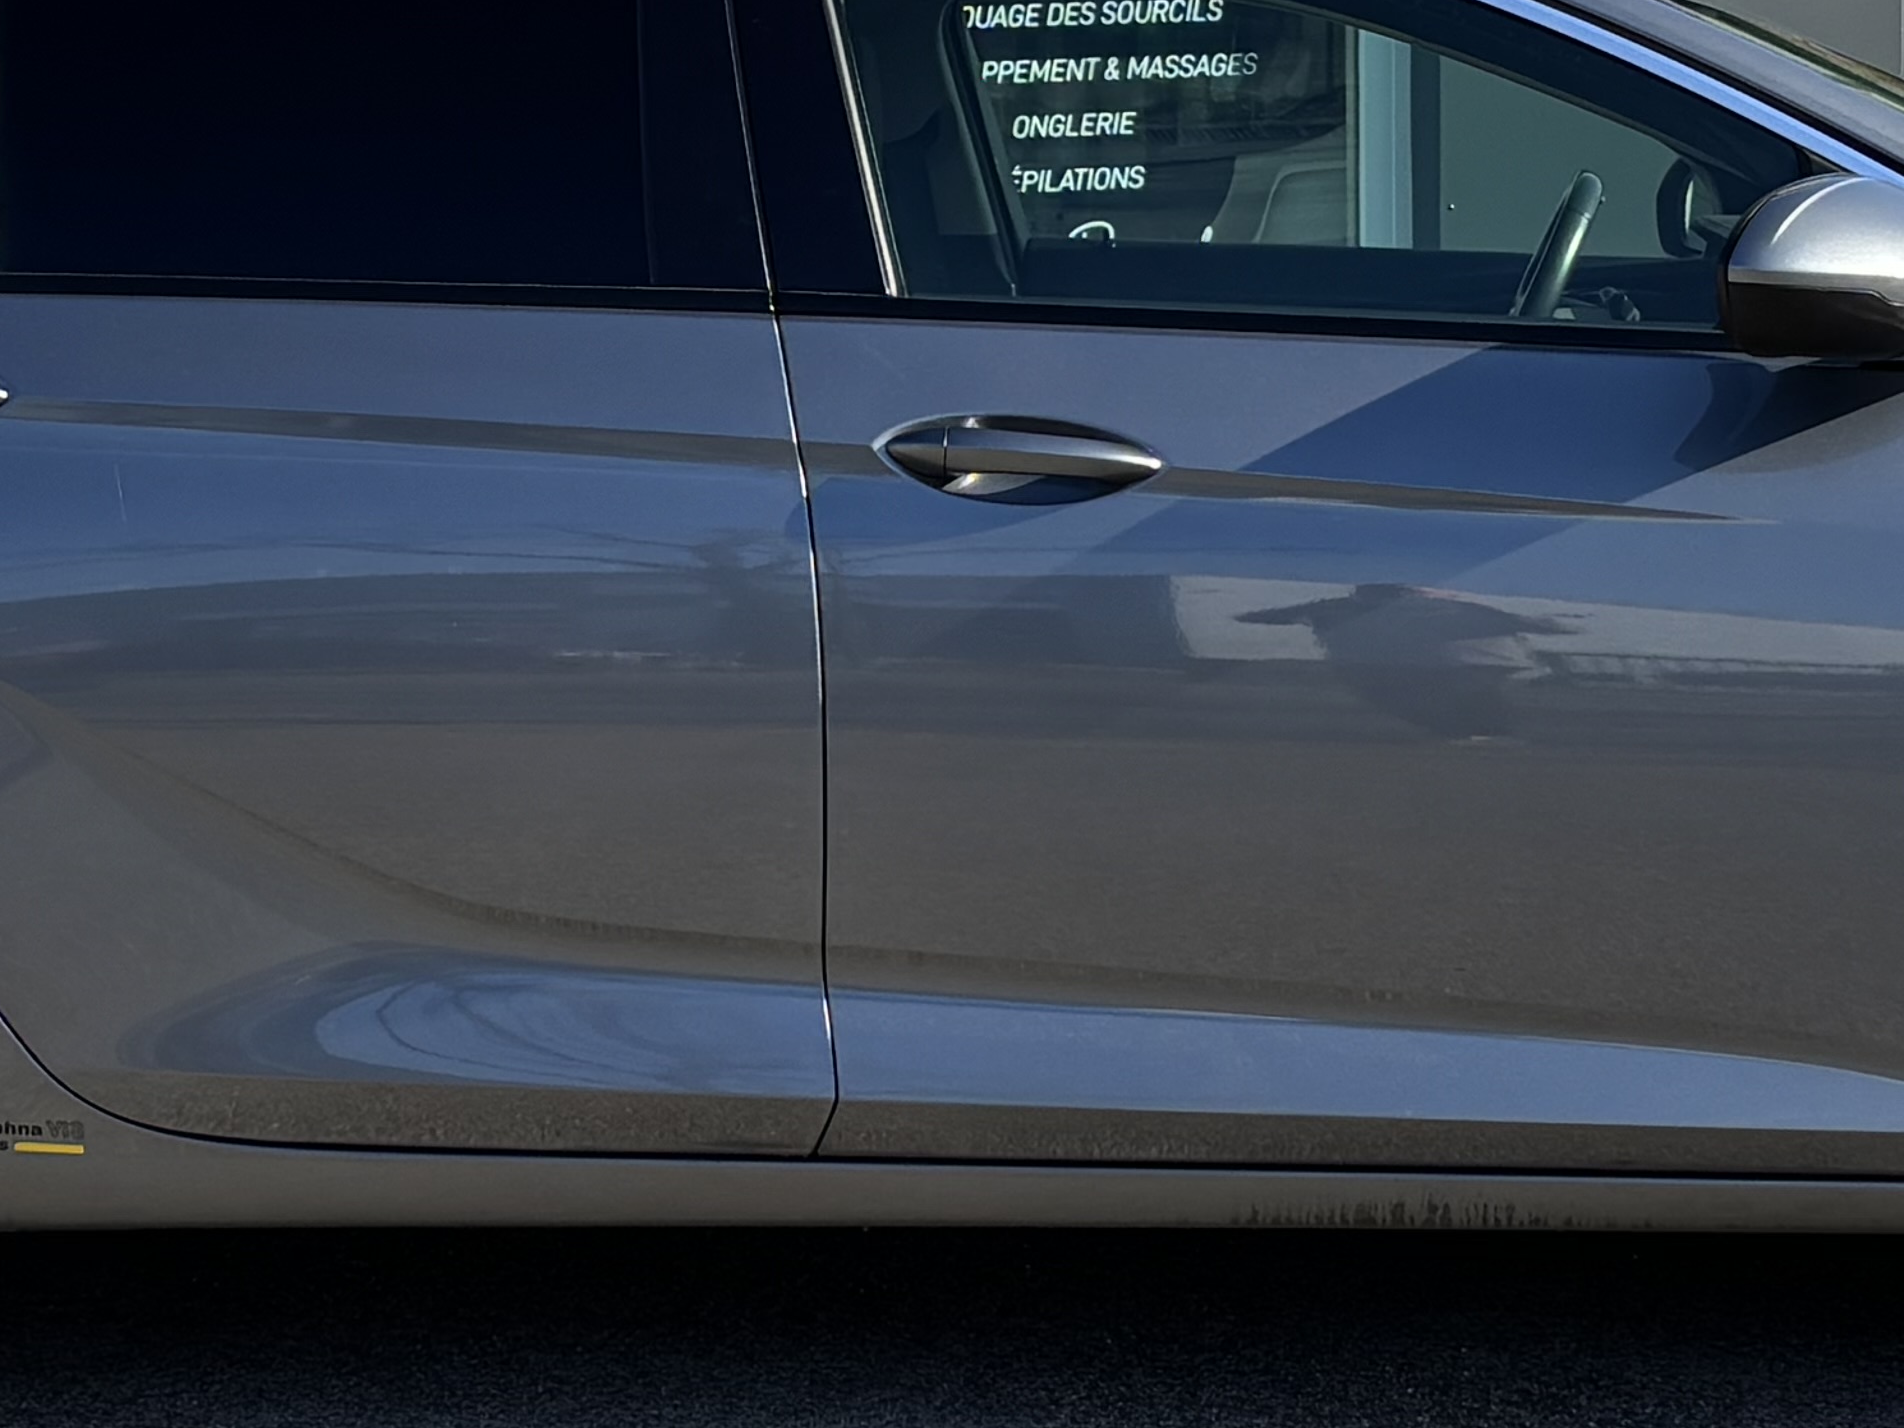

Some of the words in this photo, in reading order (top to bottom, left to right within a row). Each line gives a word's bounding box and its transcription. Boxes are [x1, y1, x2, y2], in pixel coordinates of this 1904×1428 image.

[1046, 2, 1097, 27] DES
[1103, 56, 1120, 80] &
[1126, 52, 1259, 80] MASSAGES
[1012, 111, 1137, 139] ONGLERIE
